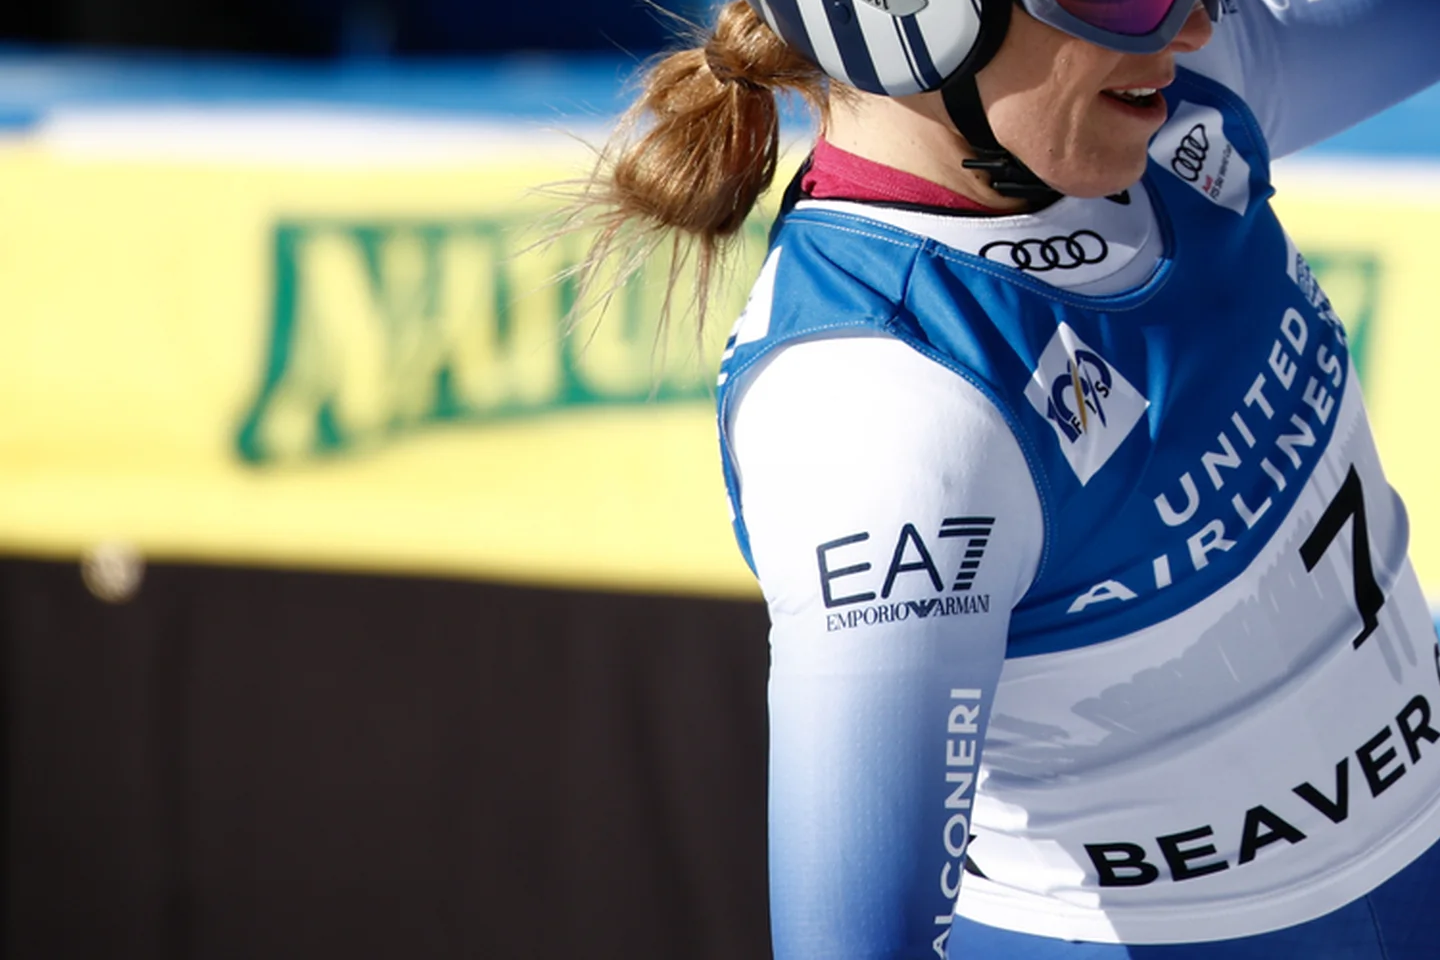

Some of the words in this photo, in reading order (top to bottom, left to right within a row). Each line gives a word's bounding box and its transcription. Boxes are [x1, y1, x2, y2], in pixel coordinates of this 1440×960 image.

[1066, 344, 1344, 613] AIRLINES
[1154, 307, 1309, 527] UNITED
[816, 516, 996, 609] EA7
[826, 601, 911, 632] EMPORIO
[932, 594, 990, 617] ARMANI
[1298, 463, 1386, 651] 7
[932, 688, 982, 960] ALCONERI
[1084, 693, 1440, 887] BEAVER
